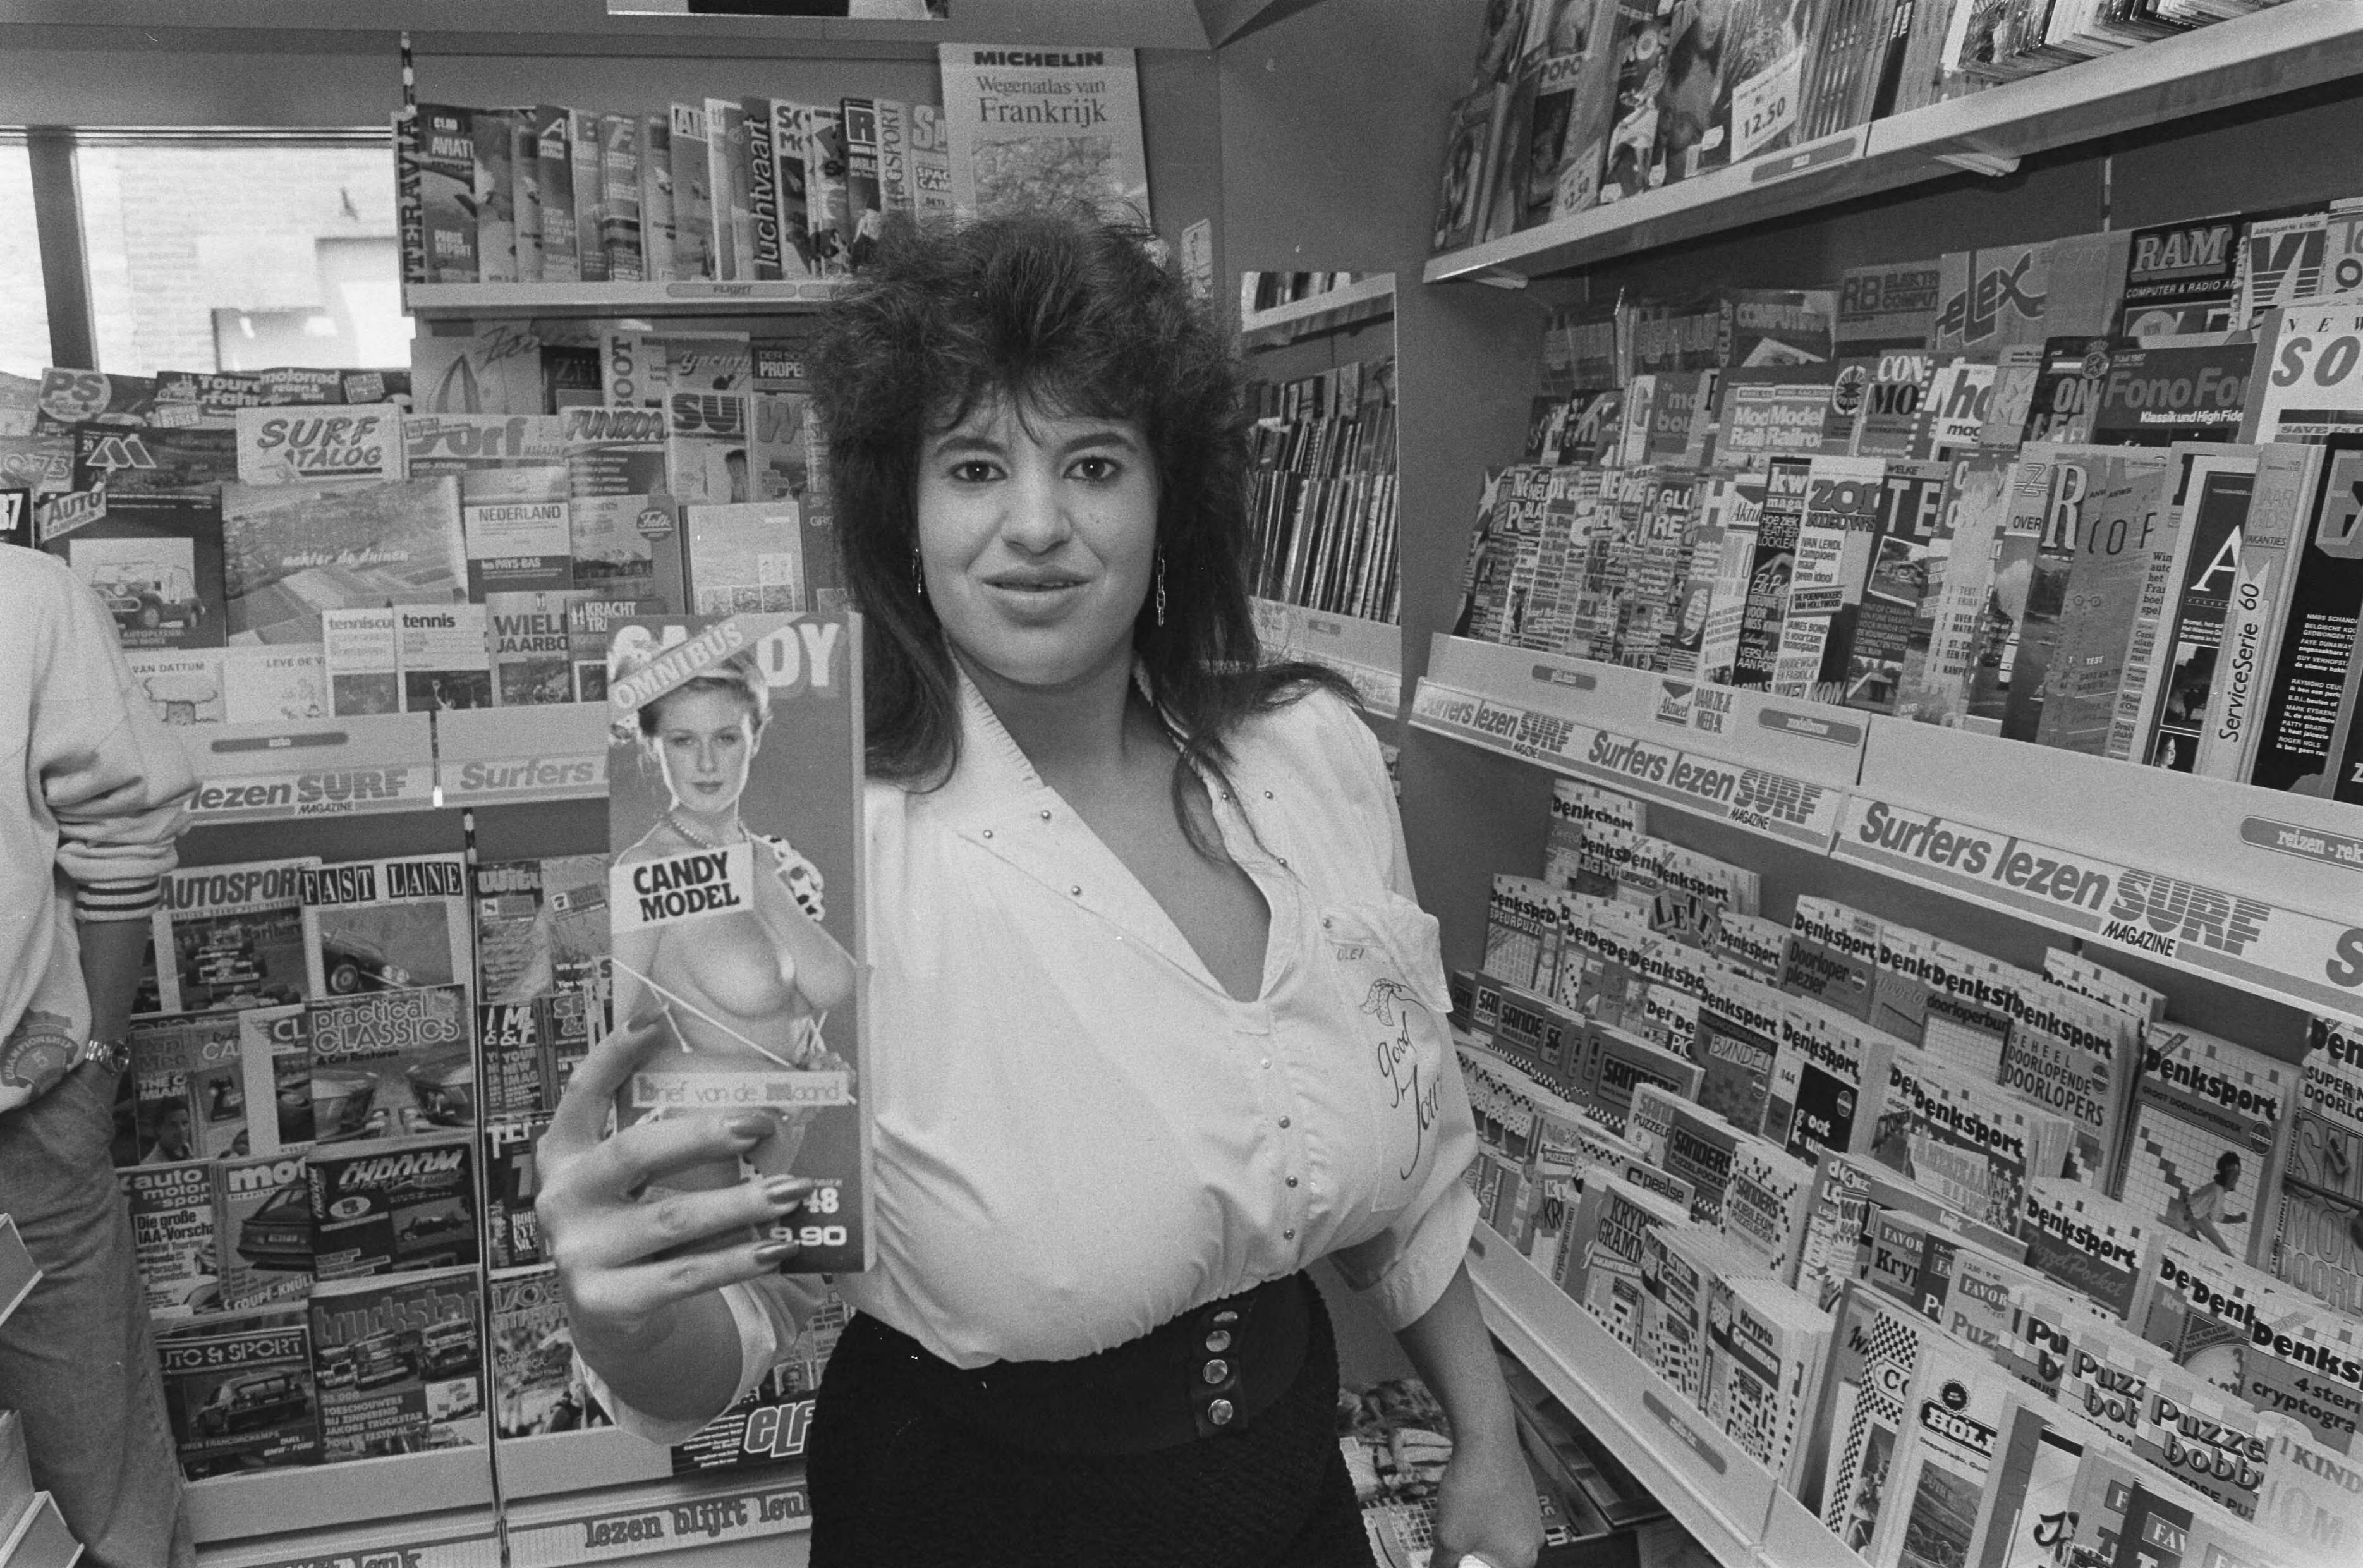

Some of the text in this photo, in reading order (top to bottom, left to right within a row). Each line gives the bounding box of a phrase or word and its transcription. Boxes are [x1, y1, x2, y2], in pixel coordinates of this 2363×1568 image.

[974, 51, 1105, 68] MICHELIN
[976, 75, 1107, 96] Wegenatlas van
[980, 96, 1107, 127] Frankrijk
[744, 118, 779, 267] luchtvaart
[2131, 224, 2233, 274] RAM
[2126, 283, 2177, 299] COMPUTER
[2188, 280, 2221, 292] RADIO
[671, 392, 746, 434] SU
[2140, 411, 2172, 423] Klassik
[2198, 411, 2219, 425] High
[258, 415, 382, 449] SURF
[49, 492, 102, 523] AUTO
[479, 506, 562, 523] NEDERLAND
[2012, 515, 2042, 531] OVER
[403, 614, 456, 629] tennis
[2302, 629, 2345, 640] GEDWONGEN
[613, 623, 744, 710] OMNIBUS
[2218, 582, 2260, 743] ServiceSerie 60
[2291, 678, 2324, 688] RAYMOND
[1473, 698, 1519, 738] lezen
[1516, 710, 1575, 753] SURF
[2281, 720, 2328, 732] PATTY BRARD
[2285, 704, 2338, 717] MARK EYSKENS
[2278, 736, 2302, 744] ROGER
[190, 769, 409, 810] lezen SURF
[459, 760, 595, 791] Surfers
[1587, 730, 1825, 825] Surfers lezen SURF
[298, 801, 355, 815] MAGAZINE
[1729, 807, 1771, 831] MAGAZINE
[2276, 829, 2326, 855] reizen
[301, 861, 463, 906] FAST LANE
[633, 851, 728, 895] CANDY
[1658, 865, 1729, 903] enksport
[1860, 800, 2273, 957] Surfers lezen SURF
[639, 883, 741, 922] MODEL
[1720, 927, 1781, 966] Denksport
[1794, 912, 1878, 959] Denksport
[2101, 920, 2177, 959] MAGAZINE
[1790, 940, 1850, 983] Doorloper
[315, 995, 428, 1028] practical
[315, 1017, 461, 1056] CLASSICS
[1782, 1019, 1861, 1077] Denksport
[2008, 1045, 2093, 1095] DOORLOPENDE
[2145, 1047, 2278, 1122] Denksport
[2306, 1066, 2352, 1098] SUPER
[2006, 1066, 2105, 1127] DOORLOPERS
[1914, 1087, 2024, 1159] Denksport
[1674, 1126, 1733, 1176] SANDERS
[133, 1169, 203, 1189] auto
[142, 1182, 210, 1200] motor
[802, 1187, 839, 1213] 48
[138, 1210, 197, 1230] Die große
[2027, 1196, 2138, 1269] Denksport
[1884, 1227, 1924, 1253] FAVOR
[1963, 1279, 2008, 1306] FAVOR
[229, 1337, 302, 1361] SPORT
[2251, 1320, 2363, 1386] Denks
[2294, 1377, 2310, 1393] 4
[585, 1516, 664, 1548] lezen
